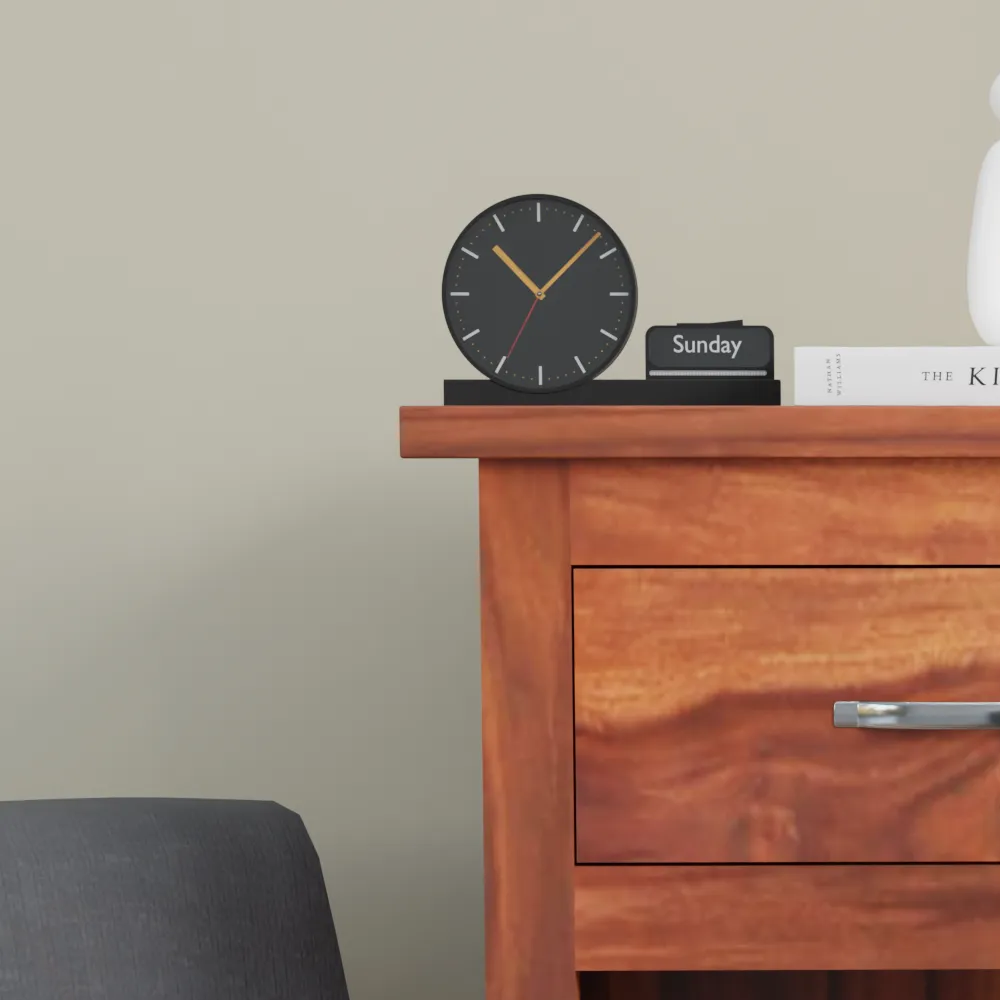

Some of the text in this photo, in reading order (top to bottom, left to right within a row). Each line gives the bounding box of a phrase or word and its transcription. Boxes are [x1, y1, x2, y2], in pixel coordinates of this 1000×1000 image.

[673, 335, 742, 359] Sunday
[825, 358, 833, 394] NATHAN
[921, 371, 953, 382] THE
